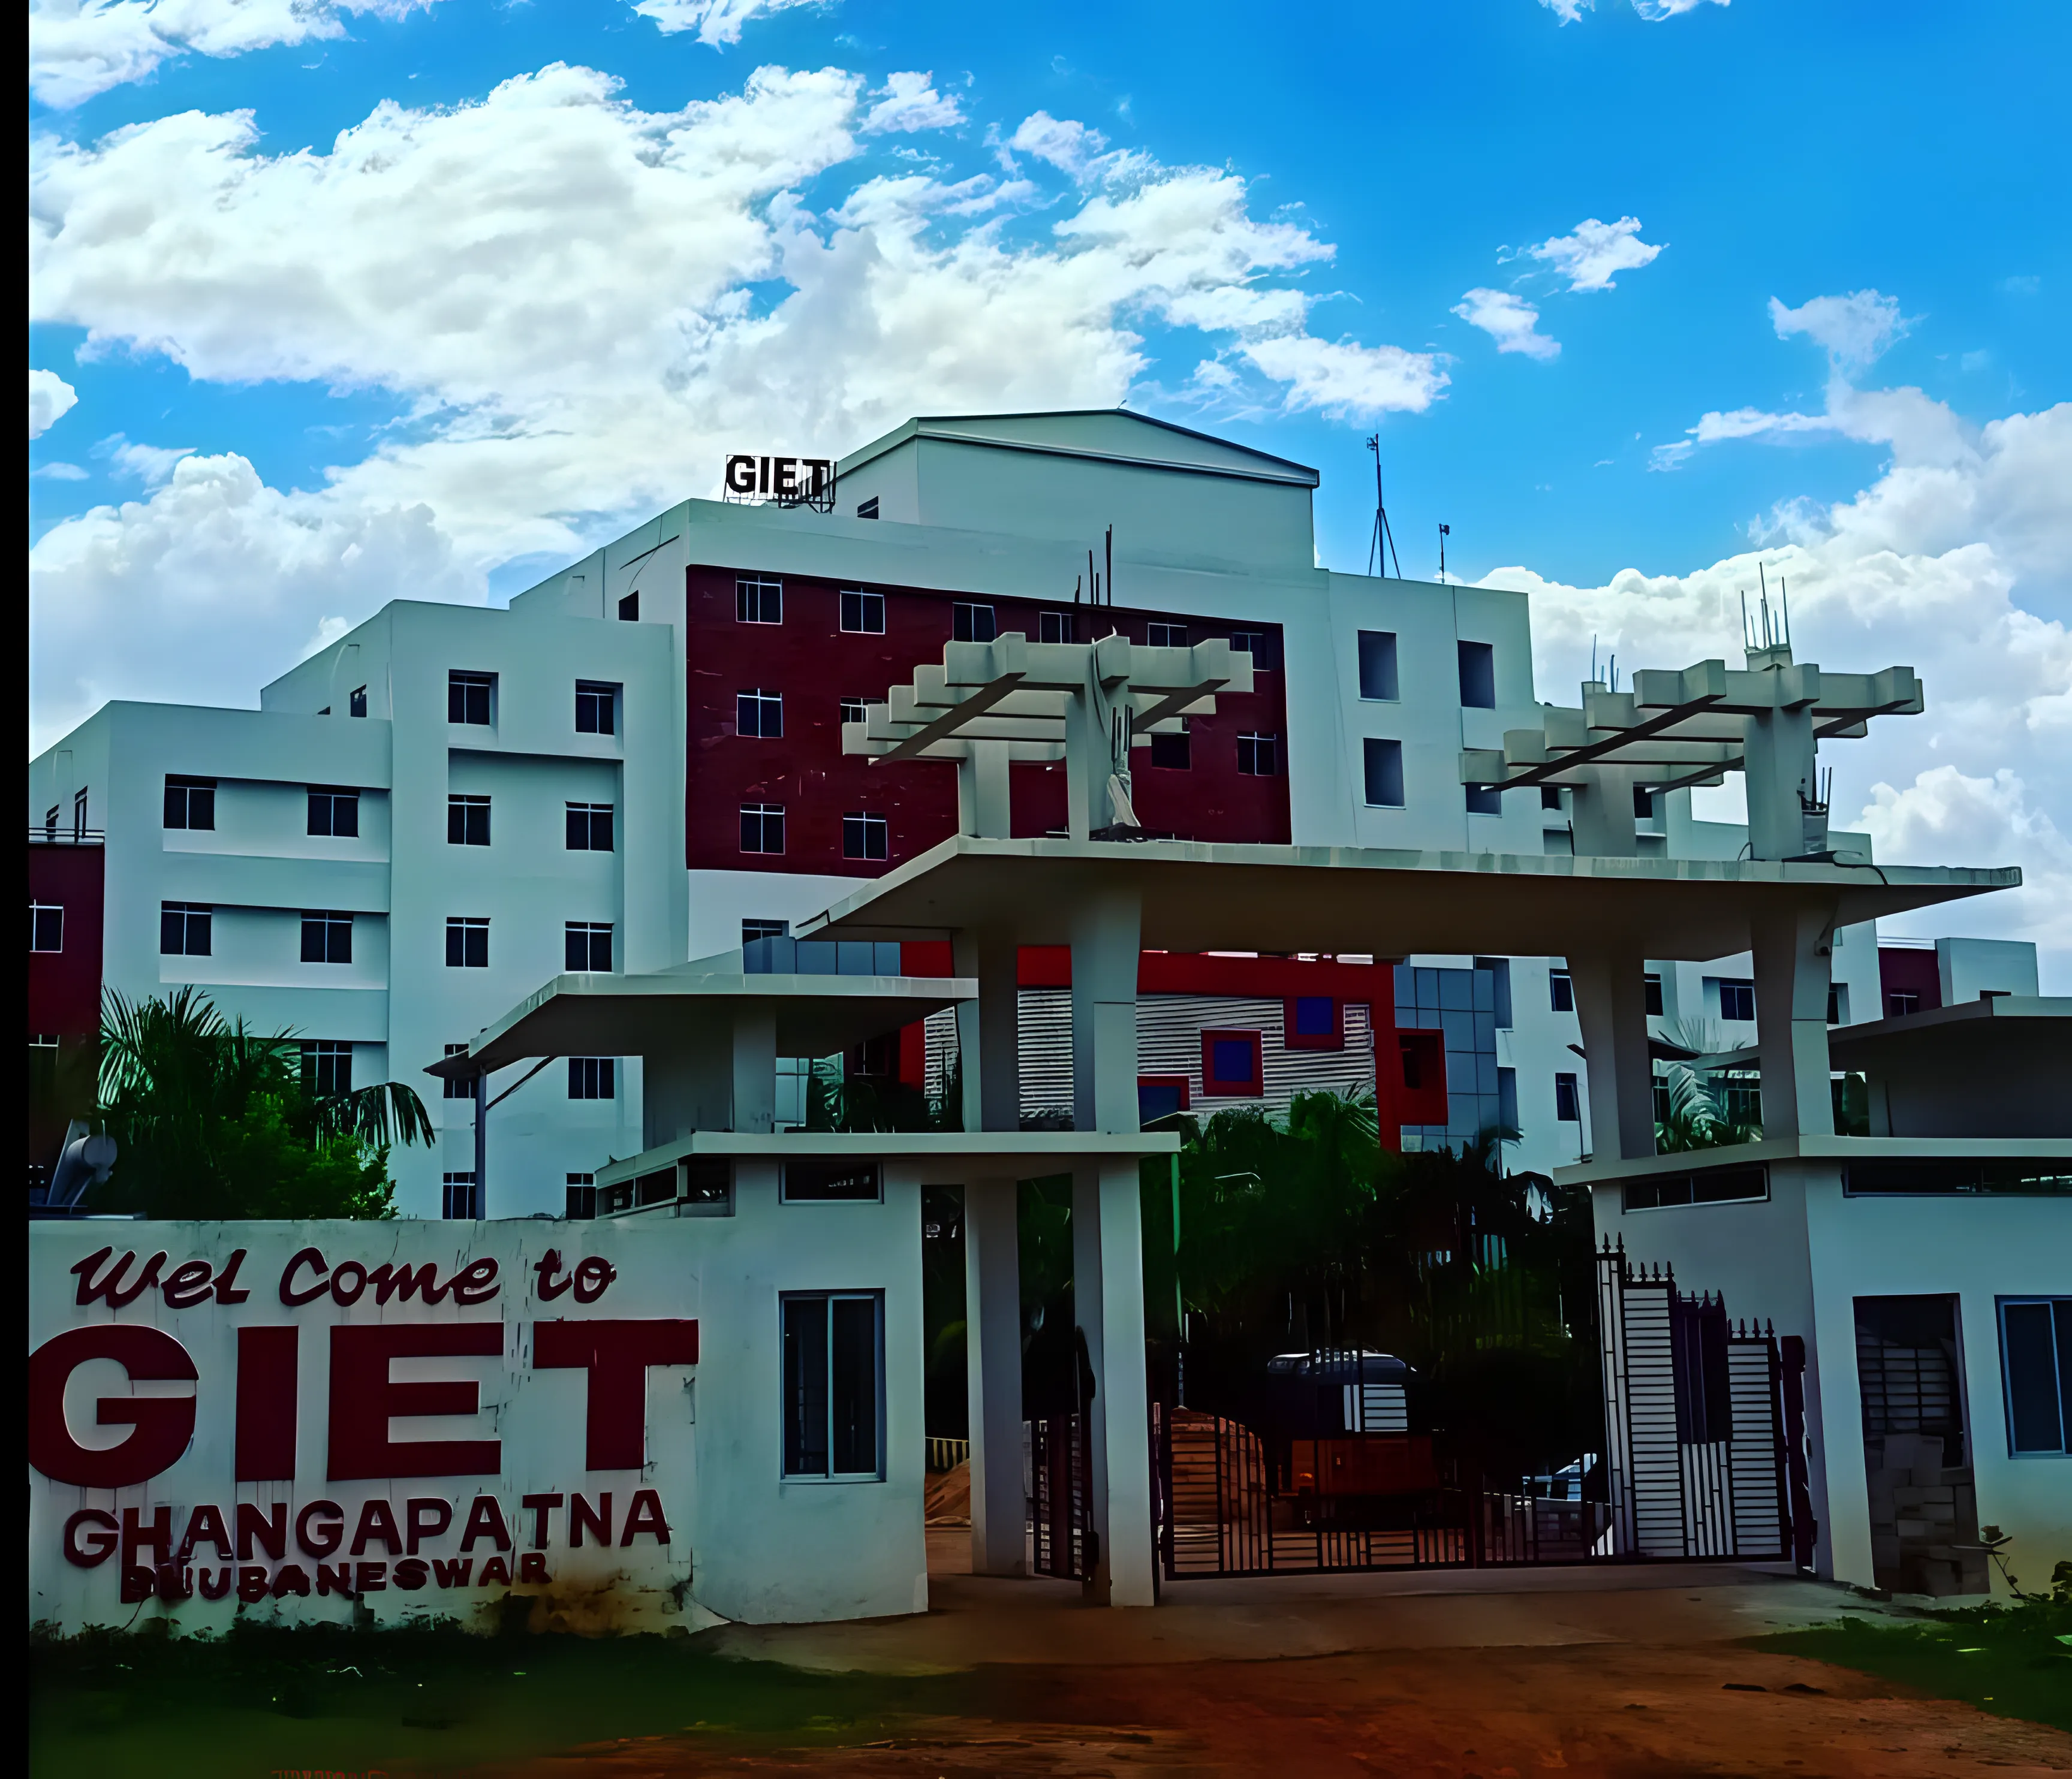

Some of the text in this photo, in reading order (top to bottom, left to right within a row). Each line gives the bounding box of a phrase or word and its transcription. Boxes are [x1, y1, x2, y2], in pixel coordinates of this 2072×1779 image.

[726, 456, 830, 497] GIET
[279, 1247, 501, 1307] Come
[534, 1249, 616, 1304] to
[29, 1319, 699, 1488] GIET
[64, 1489, 670, 1567] GHANGAPATNA
